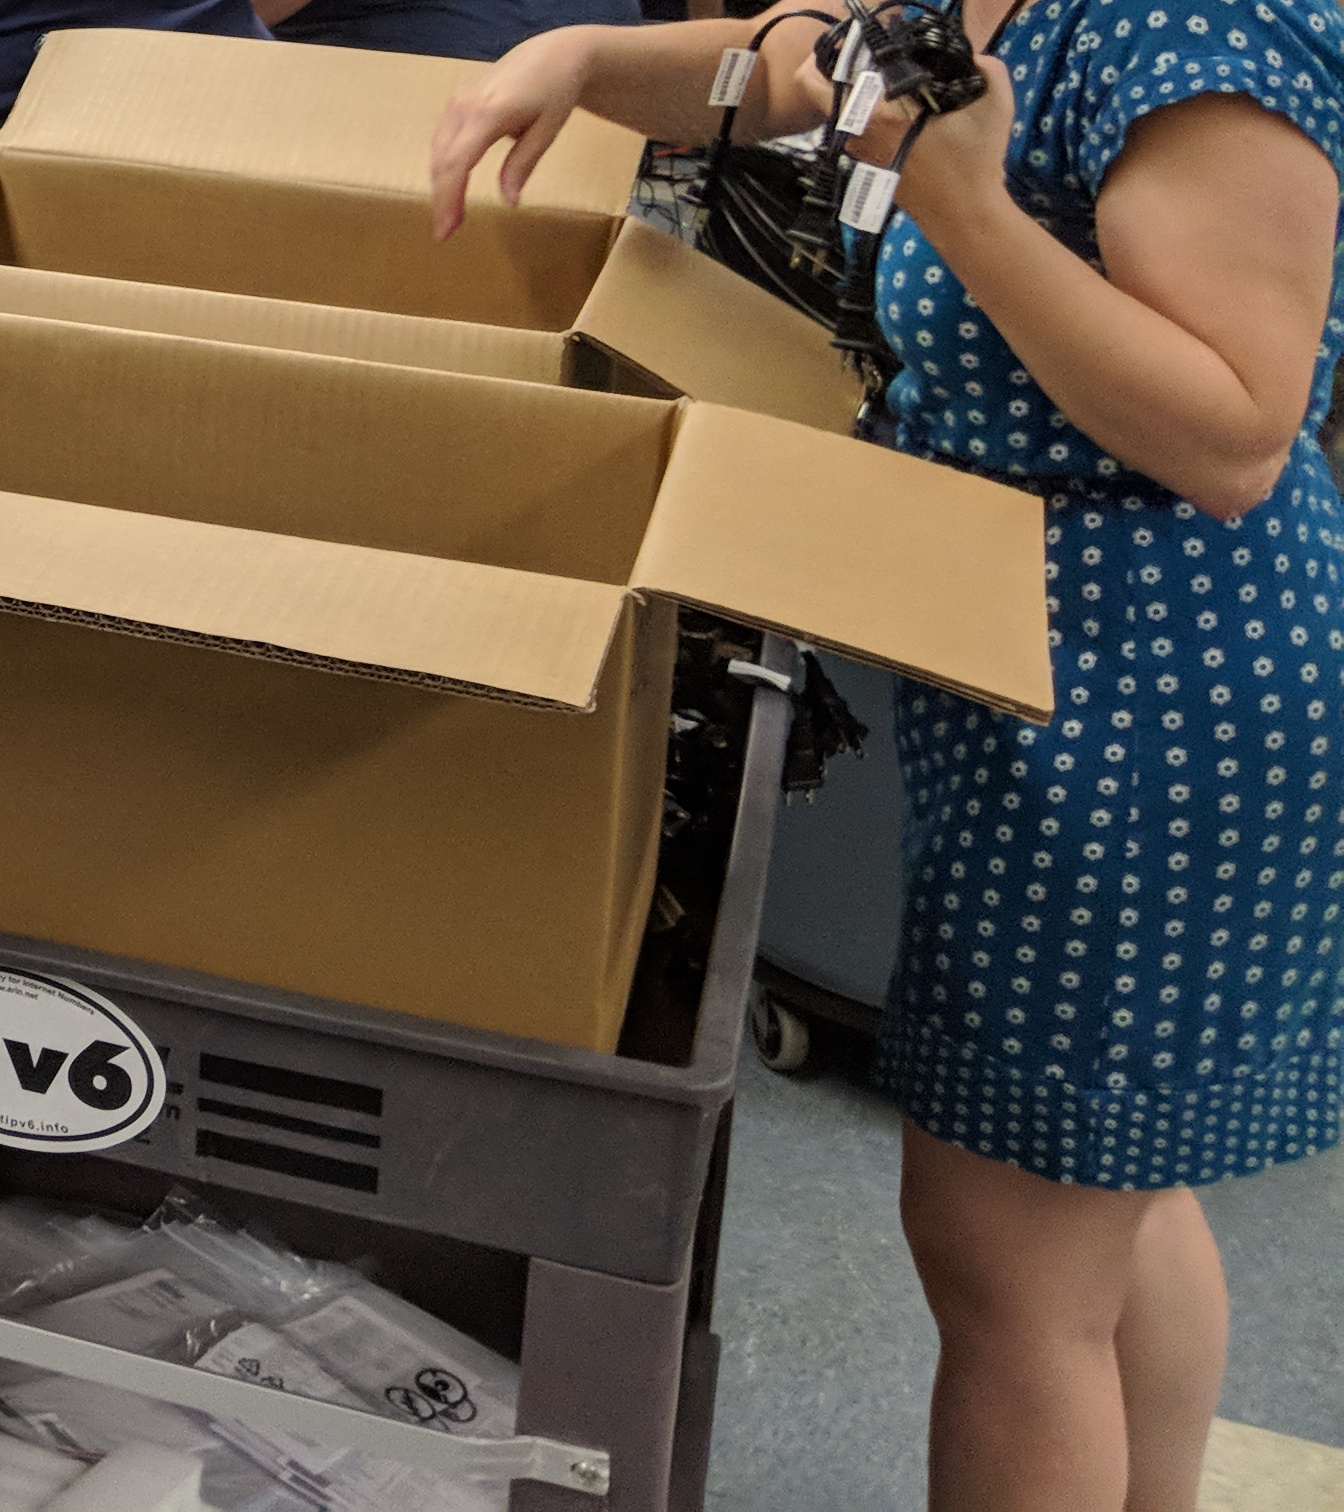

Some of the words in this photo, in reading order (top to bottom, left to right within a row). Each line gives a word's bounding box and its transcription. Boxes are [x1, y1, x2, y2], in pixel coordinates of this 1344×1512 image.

[7, 974, 21, 985] for
[22, 978, 56, 996] Internet
[57, 990, 95, 1015] Numbers
